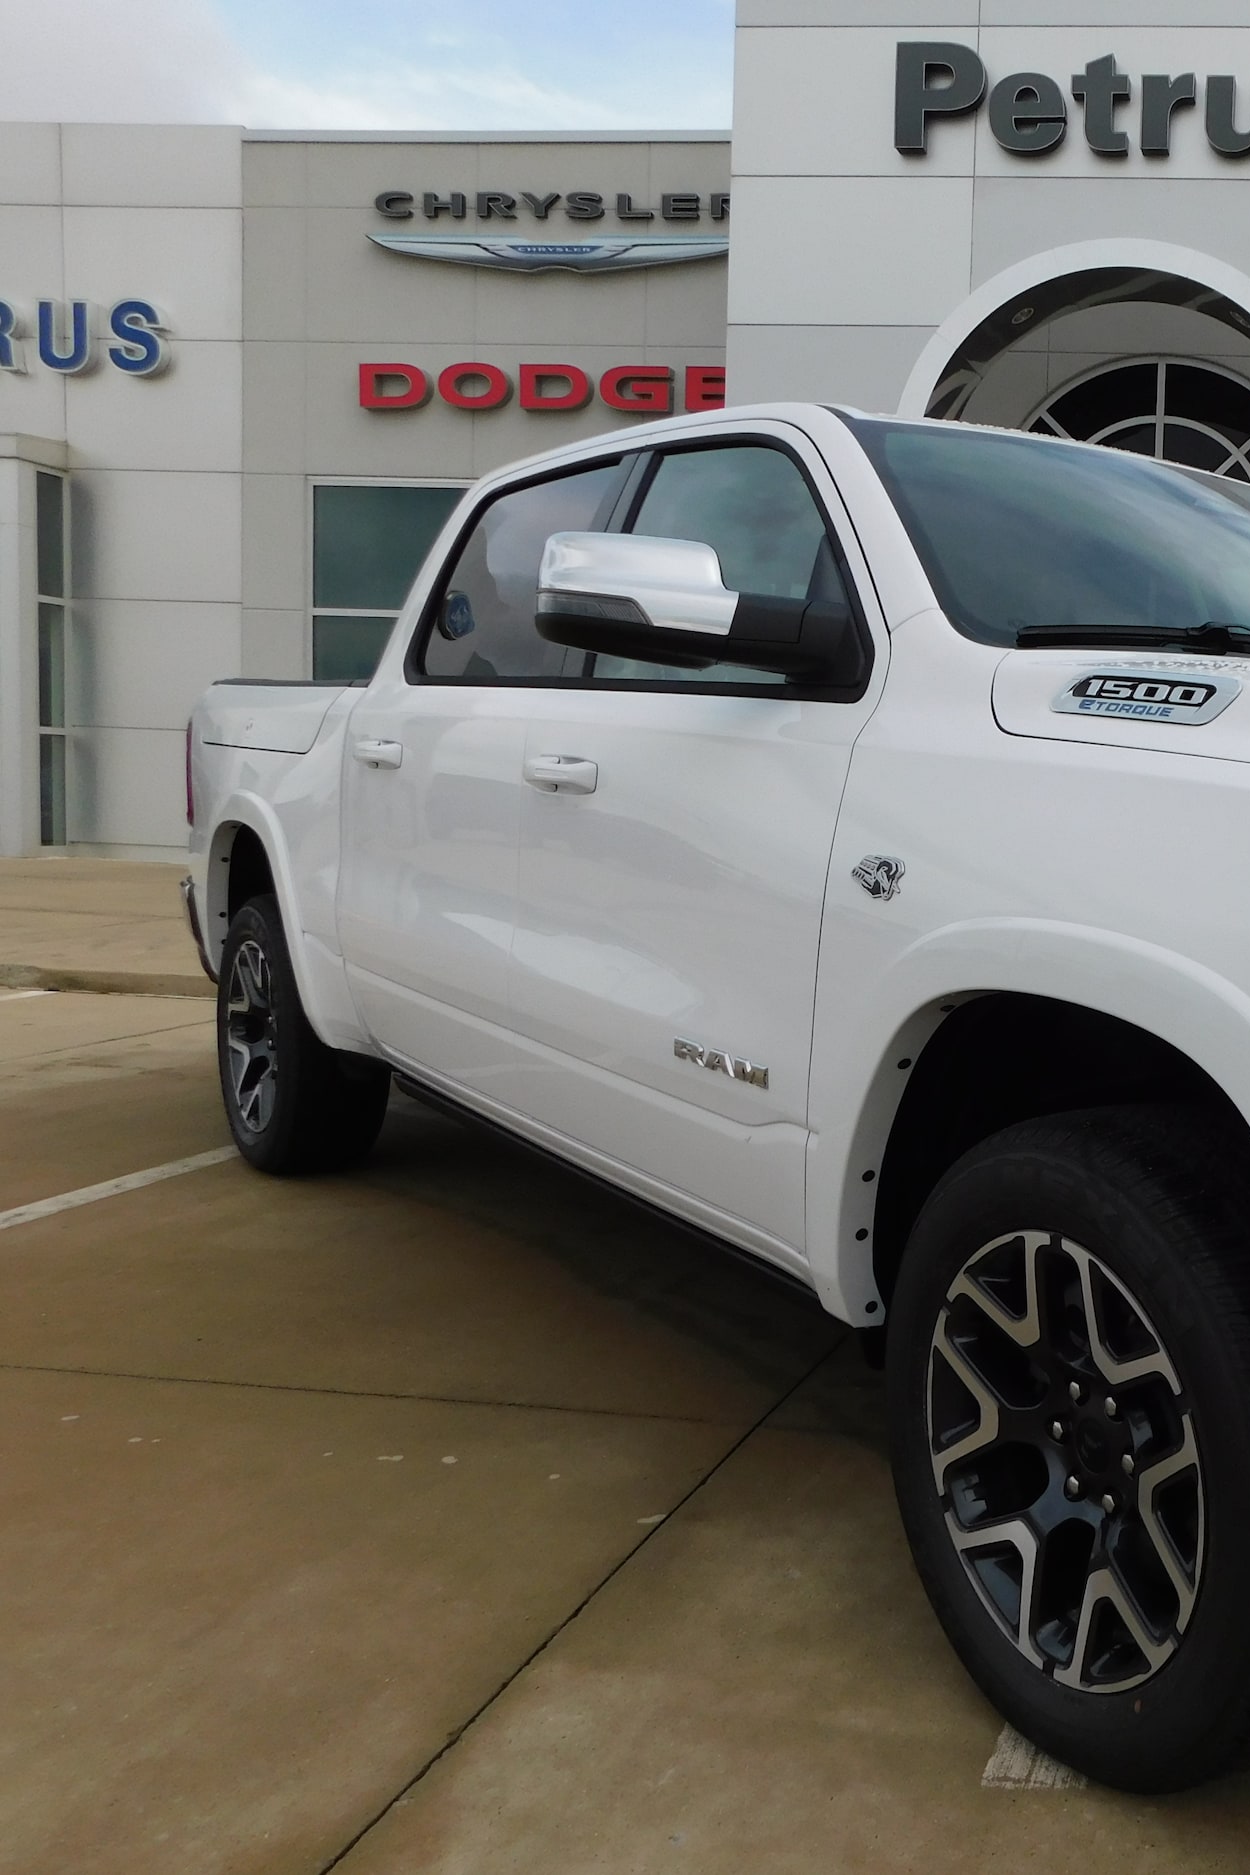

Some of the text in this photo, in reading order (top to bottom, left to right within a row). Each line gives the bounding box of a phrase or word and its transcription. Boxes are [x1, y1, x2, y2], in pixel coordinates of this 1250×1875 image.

[517, 245, 592, 254] CHRYSLER
[359, 362, 726, 413] DODGE
[1086, 679, 1208, 705] 1500
[673, 1035, 770, 1090] RAM
